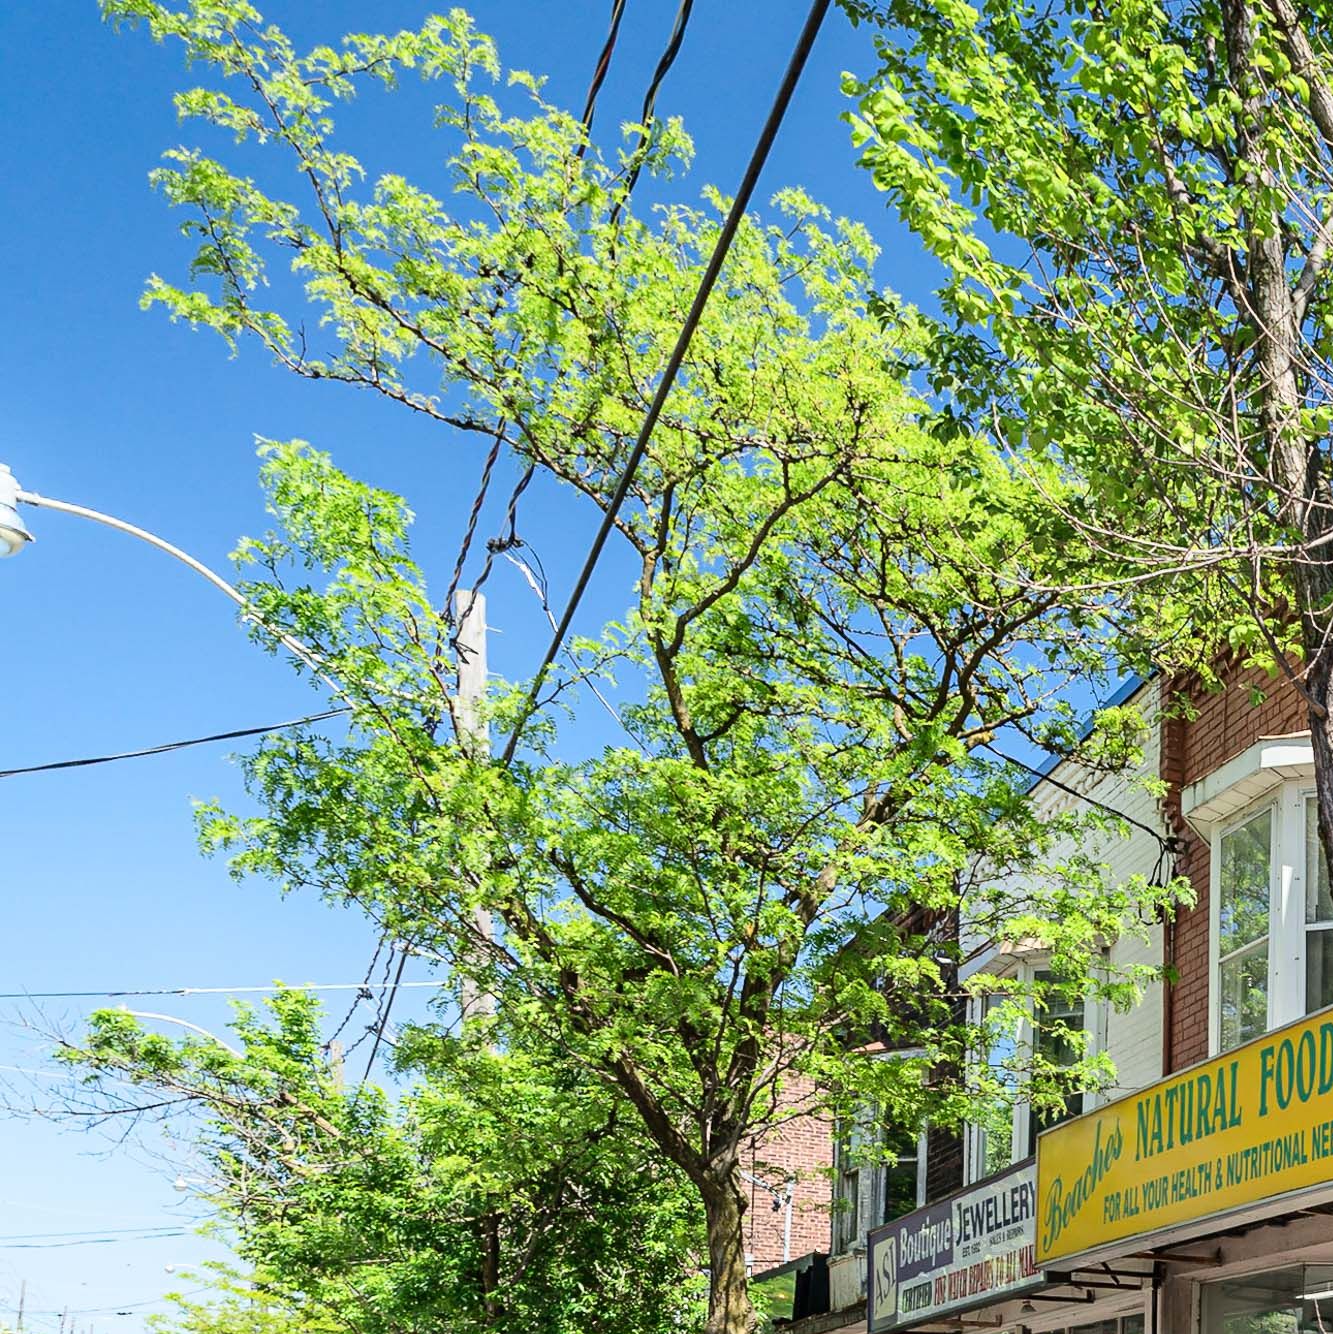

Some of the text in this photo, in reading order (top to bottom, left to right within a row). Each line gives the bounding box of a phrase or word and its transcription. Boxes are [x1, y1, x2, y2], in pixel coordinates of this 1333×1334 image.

[1042, 1116, 1124, 1253] Beaches
[1135, 1060, 1243, 1162] NATURAL
[1103, 1194, 1121, 1224] FOR
[1122, 1188, 1140, 1219] ALL
[1142, 1179, 1170, 1211] YOUR
[1171, 1162, 1213, 1203] HEALTH
[1215, 1162, 1224, 1188] &
[1226, 1129, 1308, 1187] NUTRITIONAL
[900, 1215, 951, 1268] Boutique
[955, 1181, 1036, 1248] JEWELLERY
